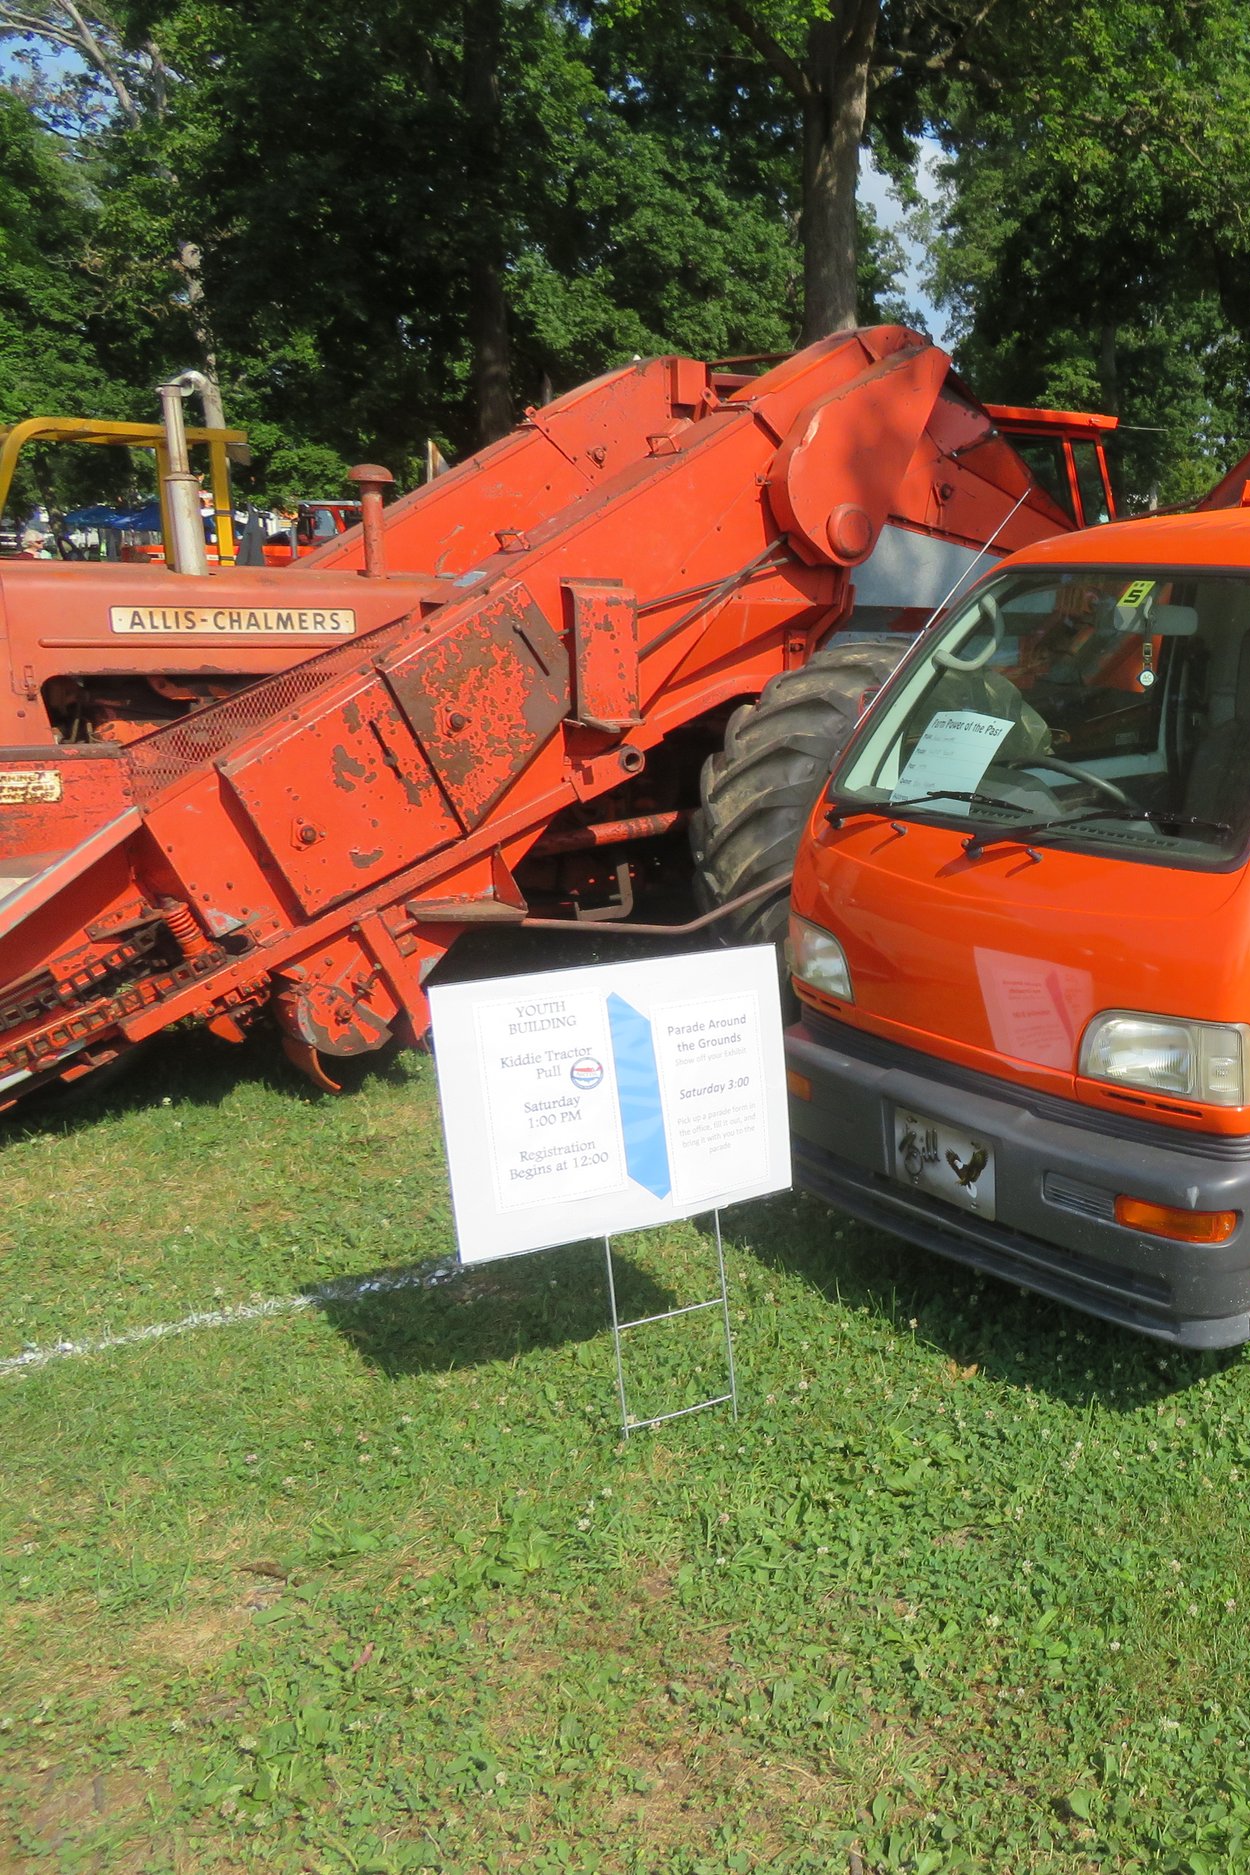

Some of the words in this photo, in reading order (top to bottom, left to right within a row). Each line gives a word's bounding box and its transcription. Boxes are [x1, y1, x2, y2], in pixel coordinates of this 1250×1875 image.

[129, 610, 341, 630] ALLIS-CHALMERS
[945, 718, 965, 730] Power
[964, 721, 974, 731] of
[972, 722, 985, 733] the
[984, 724, 1003, 736] Past
[515, 1000, 566, 1018] YOUTH
[508, 1015, 577, 1035] BUILDING
[667, 1021, 706, 1036] Parade
[708, 1013, 747, 1029] Around
[677, 1041, 695, 1052] the
[698, 1032, 742, 1049] Grounds
[500, 1052, 542, 1069] Kiddie
[544, 1046, 593, 1062] Tractor
[675, 1056, 695, 1067] Show
[696, 1053, 706, 1062] off
[707, 1052, 722, 1061] your
[536, 1064, 561, 1080] Pull
[680, 1083, 725, 1100] Saturday
[727, 1076, 750, 1090] 3:00
[524, 1096, 581, 1113] Saturday
[677, 1116, 691, 1125] Pick
[692, 1115, 702, 1123] up
[707, 1107, 732, 1120] parade
[732, 1103, 748, 1112] form
[528, 1113, 557, 1128] 1:00
[560, 1109, 582, 1123] PM
[679, 1127, 691, 1136] the
[744, 1111, 756, 1121] and
[707, 1132, 721, 1142] with
[722, 1129, 735, 1139] you
[736, 1127, 744, 1135] to
[744, 1124, 755, 1133] the
[519, 1140, 596, 1163] Registration
[509, 1164, 552, 1180] Begins
[556, 1160, 568, 1171] at
[573, 1151, 609, 1168] 12:00
